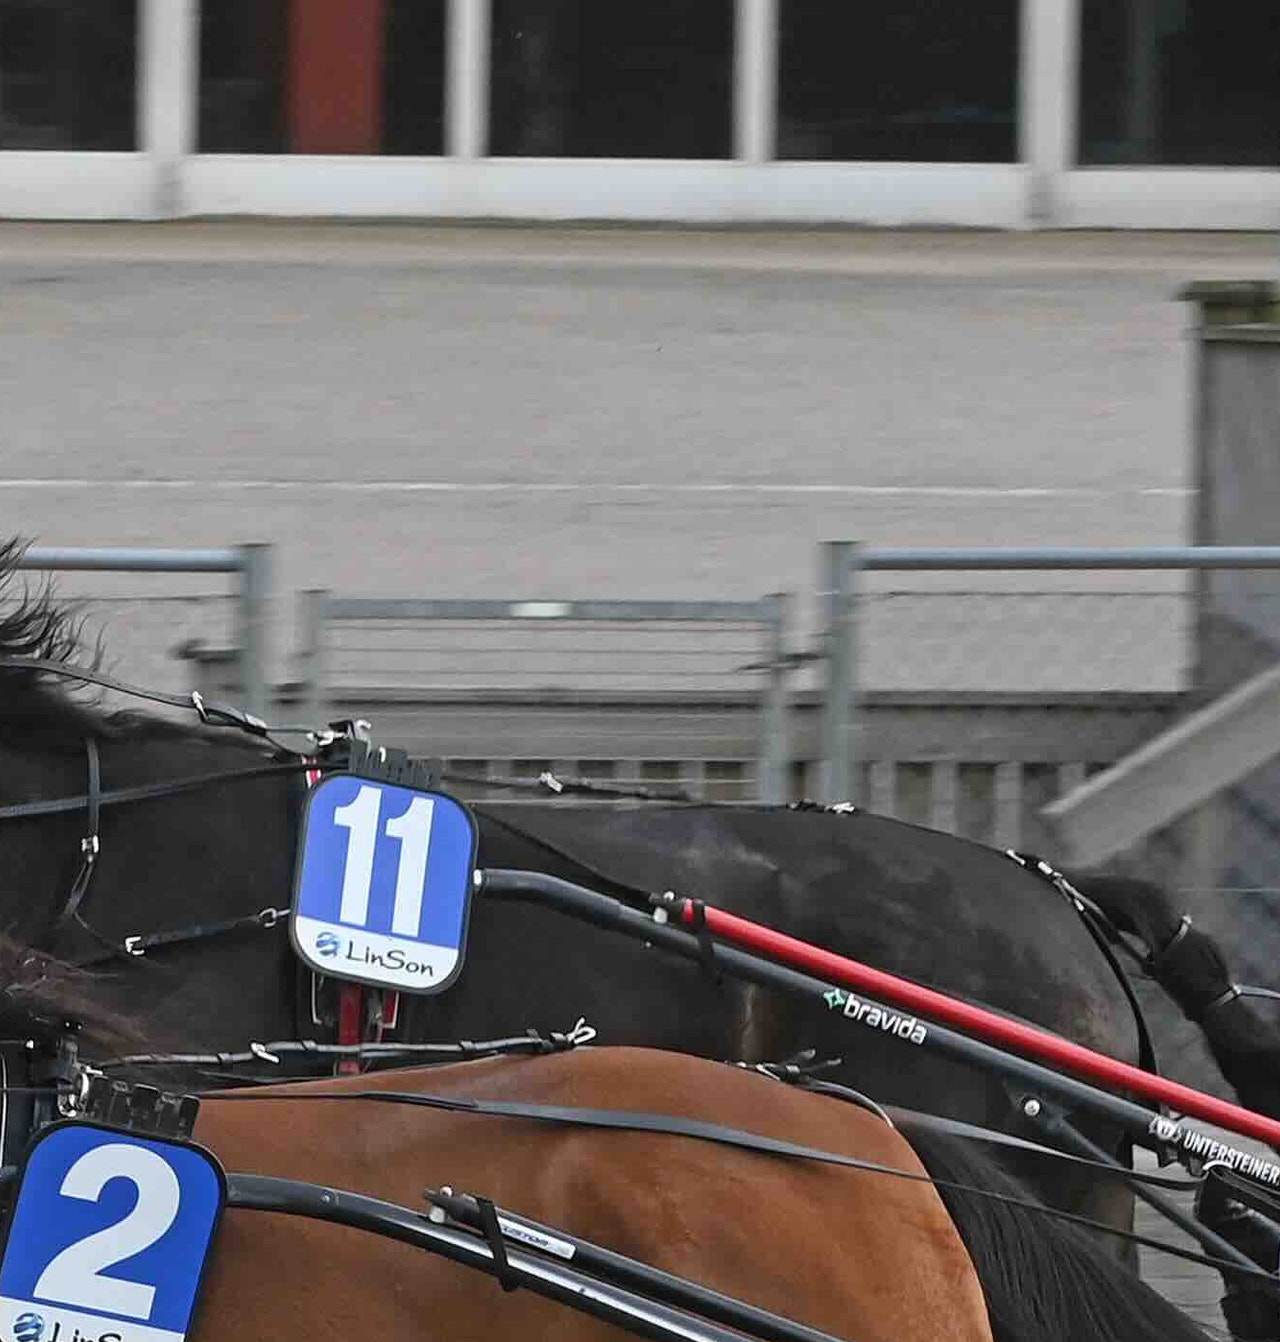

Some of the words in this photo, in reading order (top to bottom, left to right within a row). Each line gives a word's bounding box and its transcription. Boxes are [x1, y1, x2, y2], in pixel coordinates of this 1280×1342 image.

[333, 785, 435, 938] 11
[345, 940, 435, 977] LinSon
[843, 993, 928, 1046] bravida
[32, 1142, 181, 1321] 2
